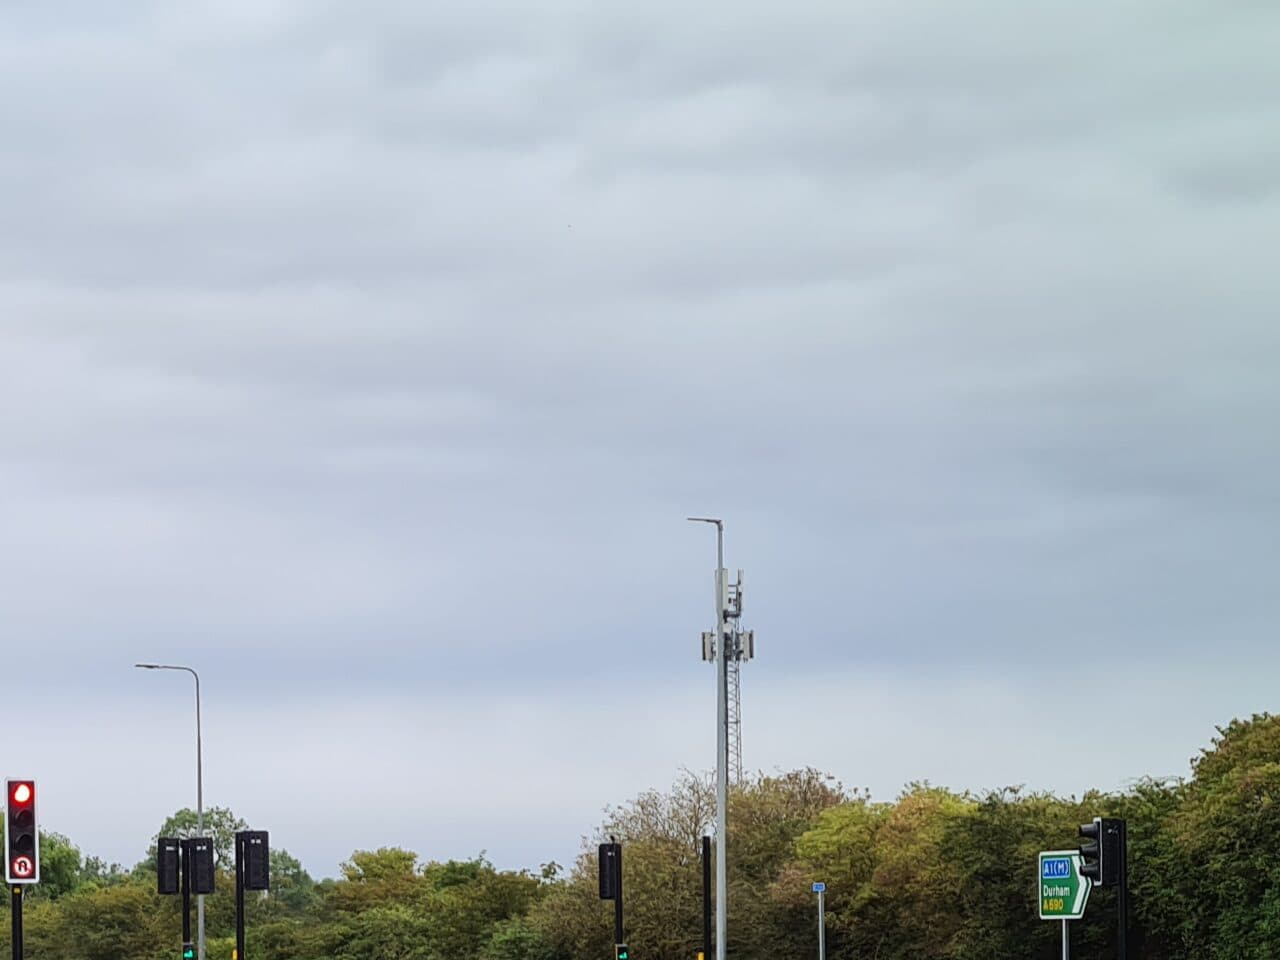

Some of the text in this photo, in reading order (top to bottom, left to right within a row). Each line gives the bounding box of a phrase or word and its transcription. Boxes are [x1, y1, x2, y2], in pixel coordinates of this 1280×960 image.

[1044, 861, 1069, 875] A1(M)
[1043, 885, 1070, 897] Durham
[1043, 898, 1064, 910] A690
